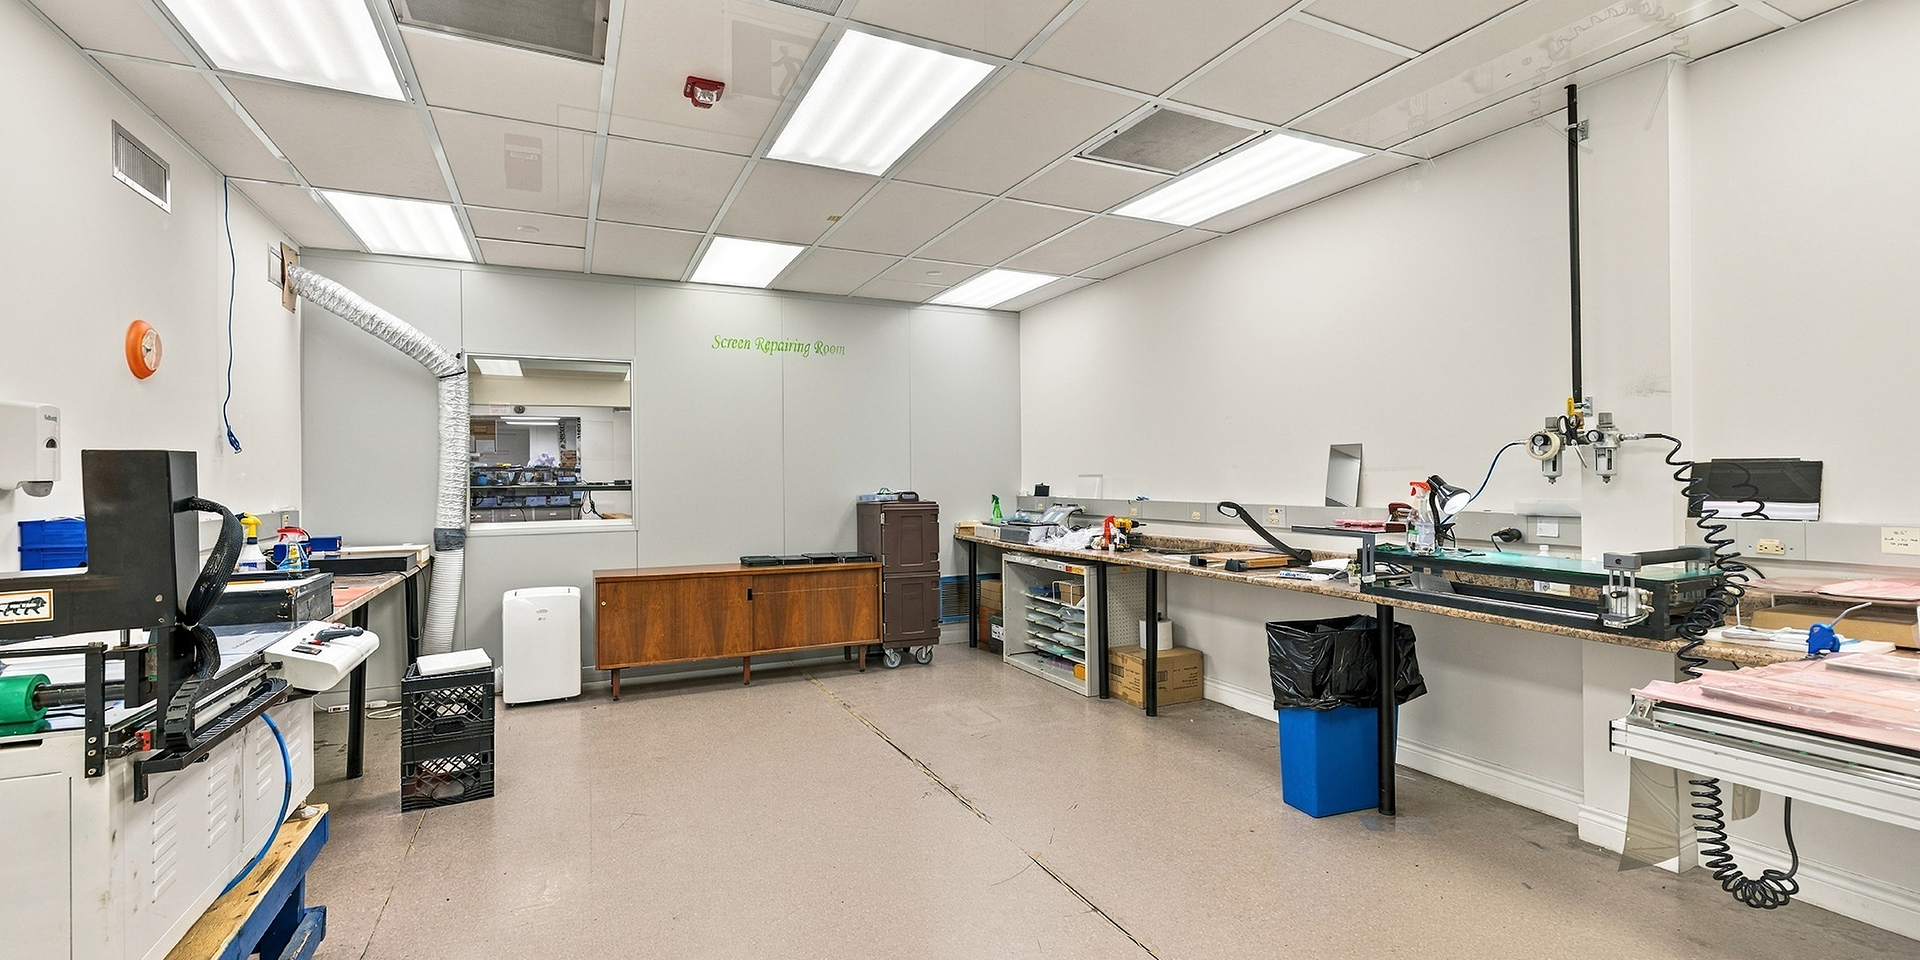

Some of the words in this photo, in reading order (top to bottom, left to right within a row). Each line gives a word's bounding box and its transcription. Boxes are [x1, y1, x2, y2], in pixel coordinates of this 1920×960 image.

[712, 335, 751, 350] Screen
[755, 336, 811, 358] Repairing
[814, 340, 845, 356] Room
